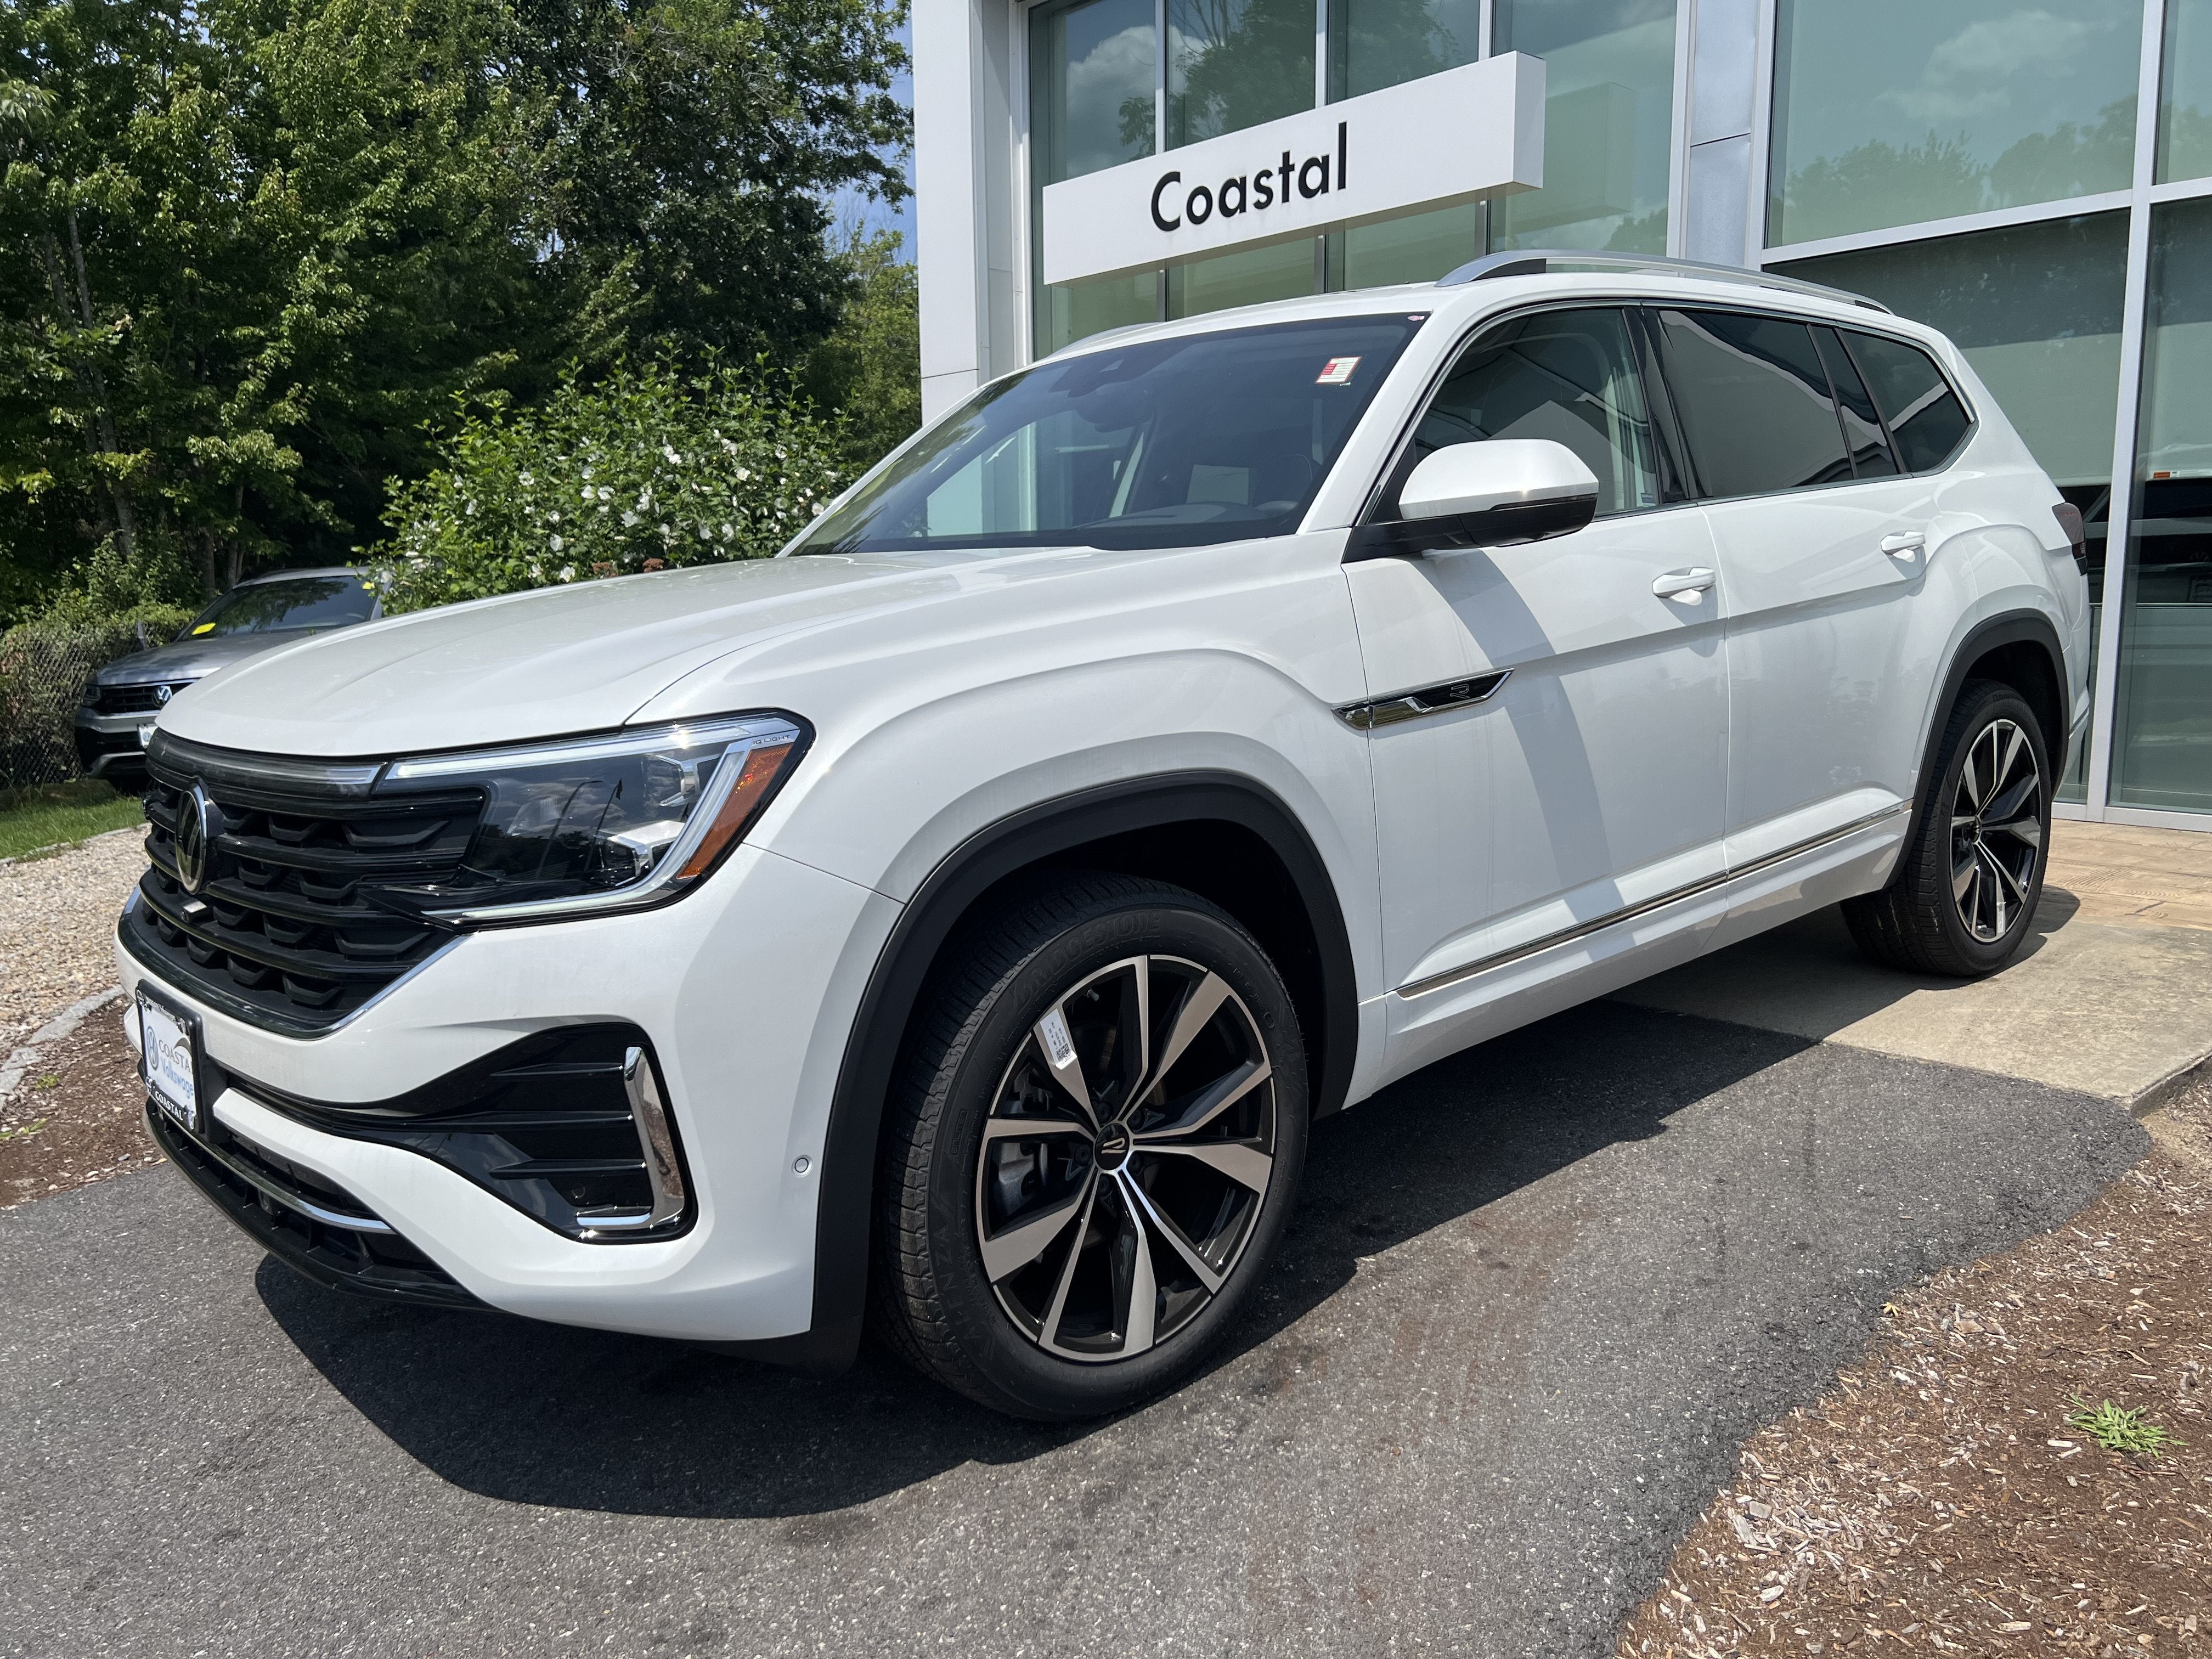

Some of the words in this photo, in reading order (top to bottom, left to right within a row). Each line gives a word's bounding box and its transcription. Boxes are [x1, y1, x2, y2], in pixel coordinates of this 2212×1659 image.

[1151, 121, 1347, 232] Coastal
[1013, 910, 1161, 1015] BRIDGESTONE
[155, 1091, 184, 1121] COASTAL
[160, 1057, 194, 1099] Volkswage
